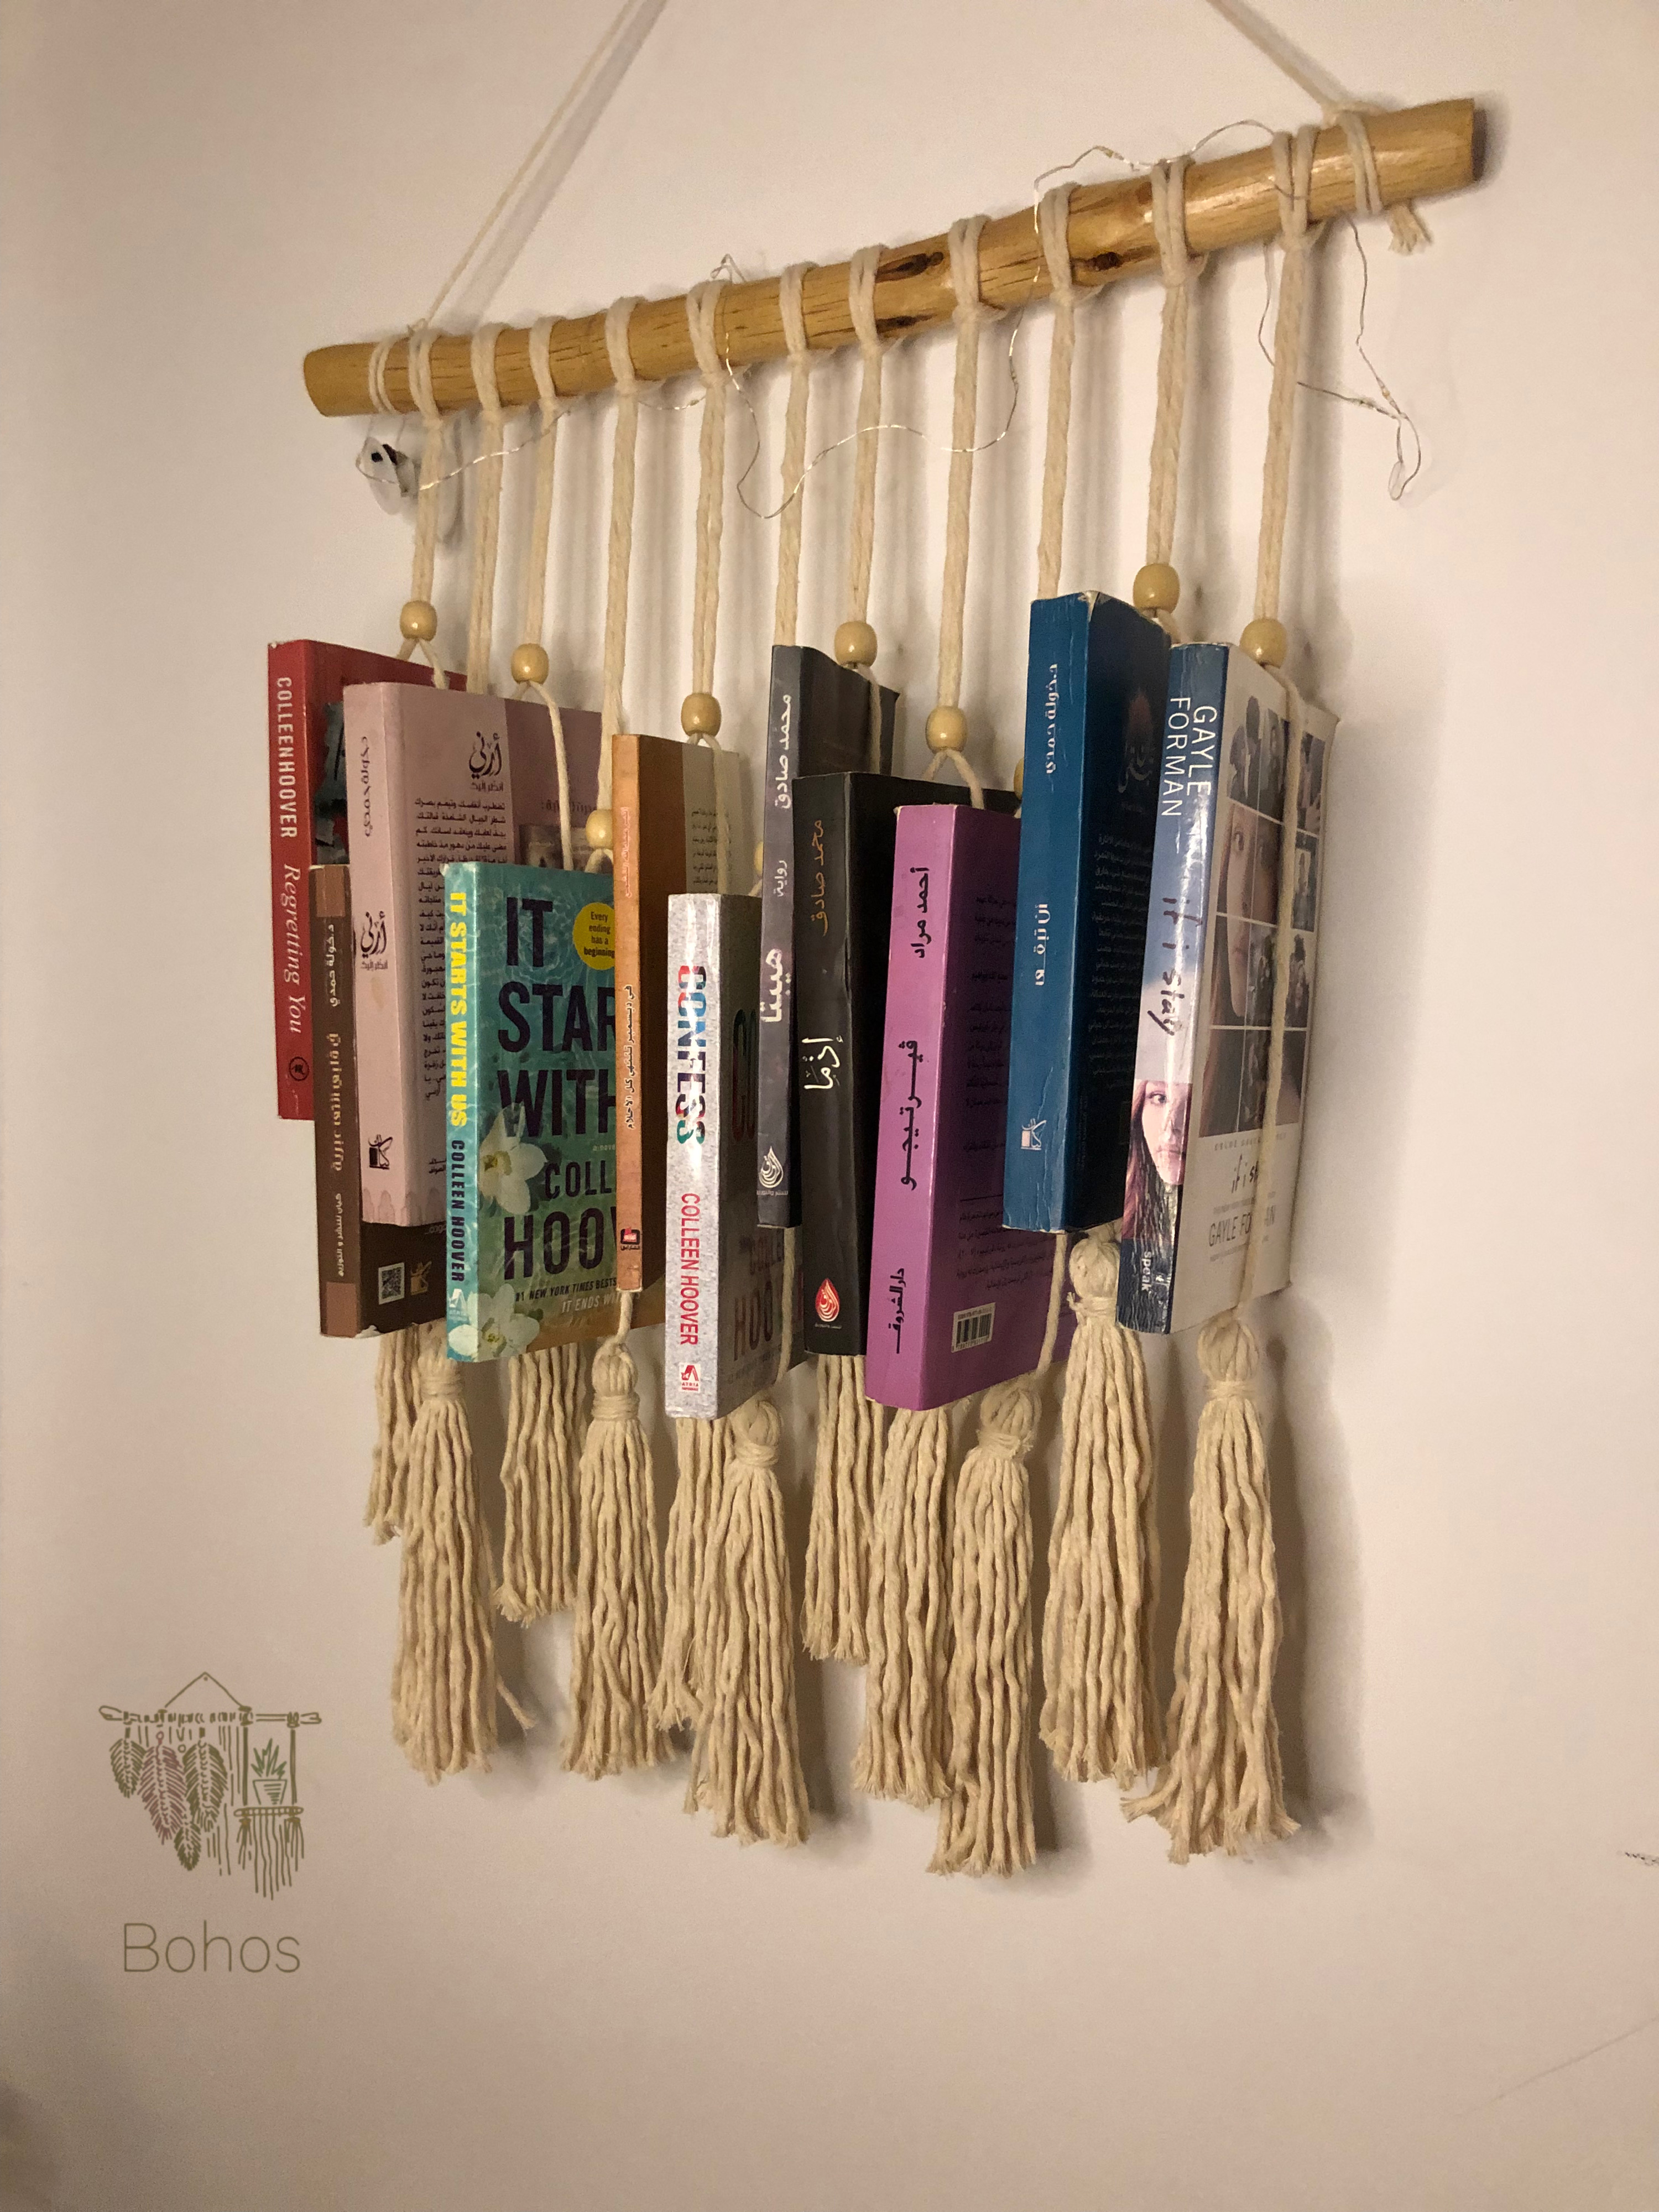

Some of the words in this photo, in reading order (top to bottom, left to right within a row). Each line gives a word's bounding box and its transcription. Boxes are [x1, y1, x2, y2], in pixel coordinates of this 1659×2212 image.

[276, 677, 294, 758] COLLEEN
[776, 694, 792, 750] محمد
[1044, 723, 1057, 774] حمدي
[1161, 697, 1191, 817] FORMAN
[1187, 706, 1218, 796] GAYLE
[279, 761, 298, 838] HOOVER
[774, 754, 792, 810] صادق
[811, 820, 825, 868] محمد
[450, 892, 467, 916] IT
[811, 872, 829, 937] صادق
[910, 866, 930, 913] أحمد
[280, 863, 304, 986] Regretting
[506, 896, 554, 968] IT
[588, 924, 611, 935] ending
[591, 911, 608, 923] Every
[591, 935, 603, 945] has
[910, 919, 932, 959] مراد
[450, 921, 467, 1015] STARTS
[583, 947, 615, 959] beginning
[328, 971, 341, 1008] حمدي
[759, 948, 792, 1022] هيبتا
[1147, 969, 1186, 1036] stay
[289, 994, 306, 1034] You
[498, 980, 616, 1053] STAR
[626, 1002, 635, 1044] ديسمبر
[450, 1020, 467, 1087] WITH
[623, 1045, 635, 1077] تنتهي
[677, 965, 708, 1145] CONFESS
[625, 1078, 635, 1093] كل
[448, 1100, 467, 1127] US
[450, 1140, 466, 1209] COLLEEN
[545, 1160, 612, 1199] COLL
[450, 1215, 466, 1282] HOOVER
[680, 1192, 701, 1270] COLLEEN
[1209, 1216, 1238, 1247] GAYLE
[529, 1289, 547, 1300] NEW
[550, 1286, 570, 1297] YORK
[572, 1282, 594, 1294] TIMES
[890, 1267, 906, 1288] دار
[561, 1301, 572, 1314] IT
[575, 1295, 599, 1311] ENDS
[680, 1274, 700, 1346] HOOVER
